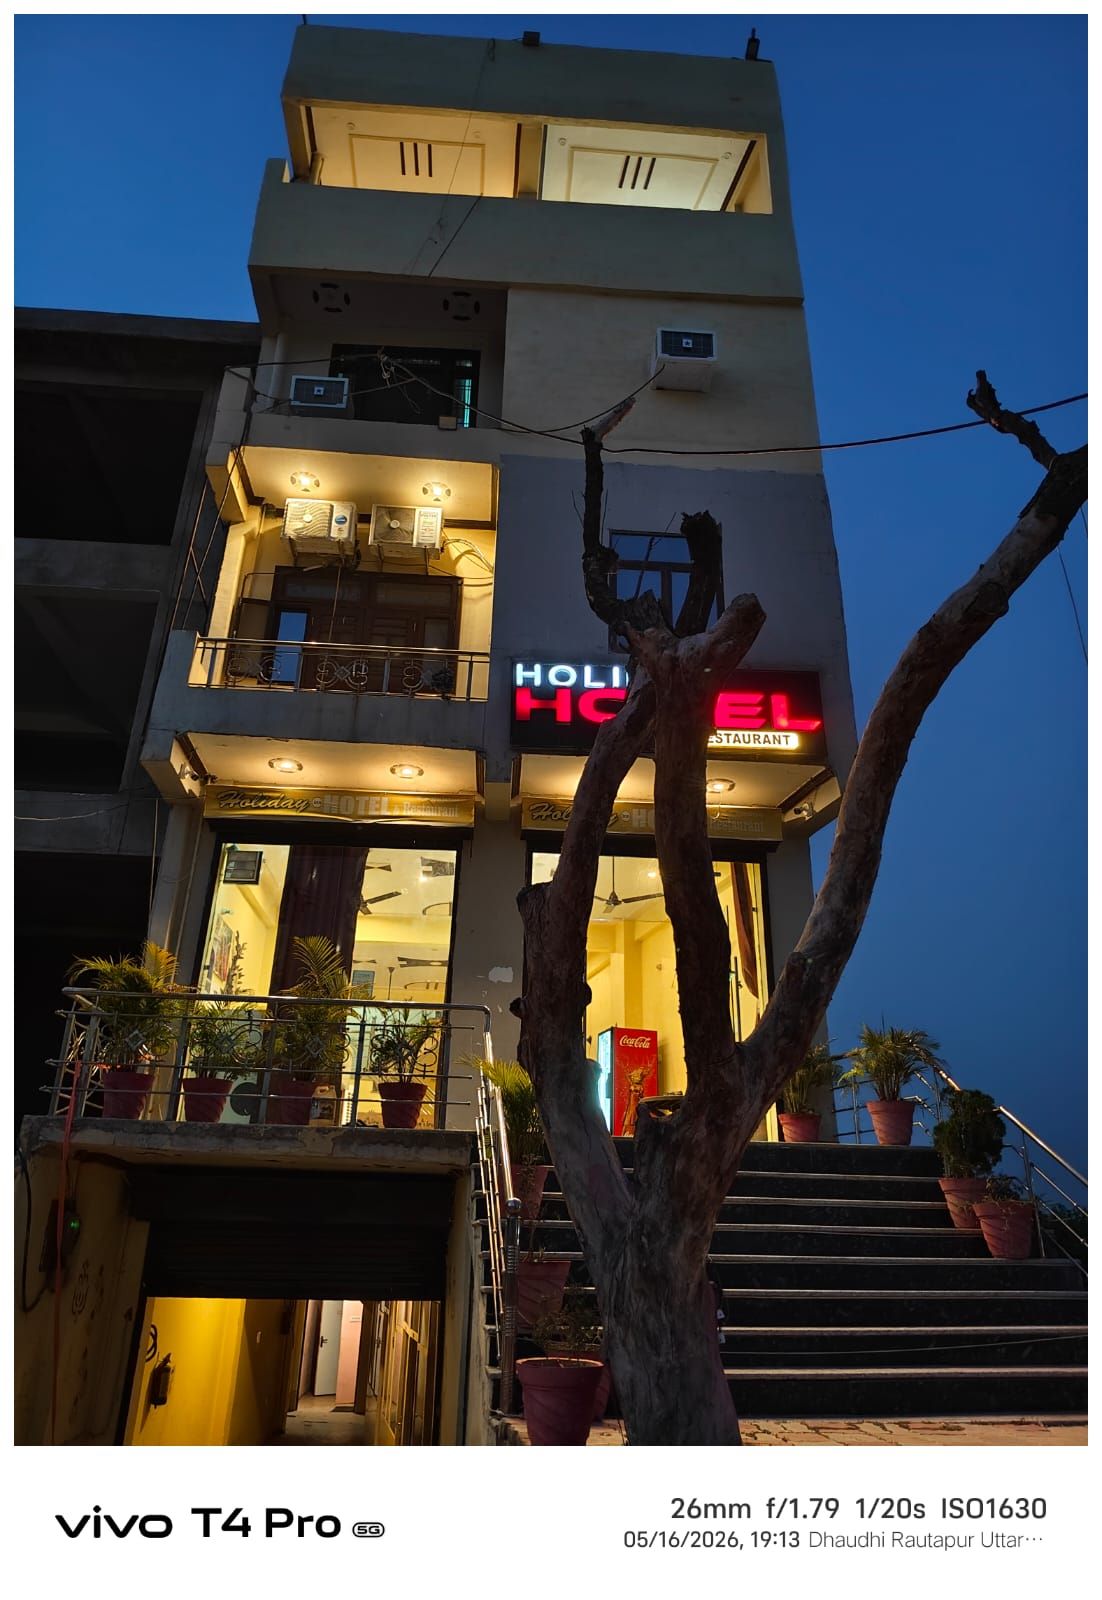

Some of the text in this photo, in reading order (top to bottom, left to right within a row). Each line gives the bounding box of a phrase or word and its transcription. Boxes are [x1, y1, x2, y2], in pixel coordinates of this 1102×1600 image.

[515, 663, 629, 689] HOLI
[515, 687, 823, 731] HOEL
[217, 790, 311, 813] Holiday
[322, 793, 390, 816] HOTEL
